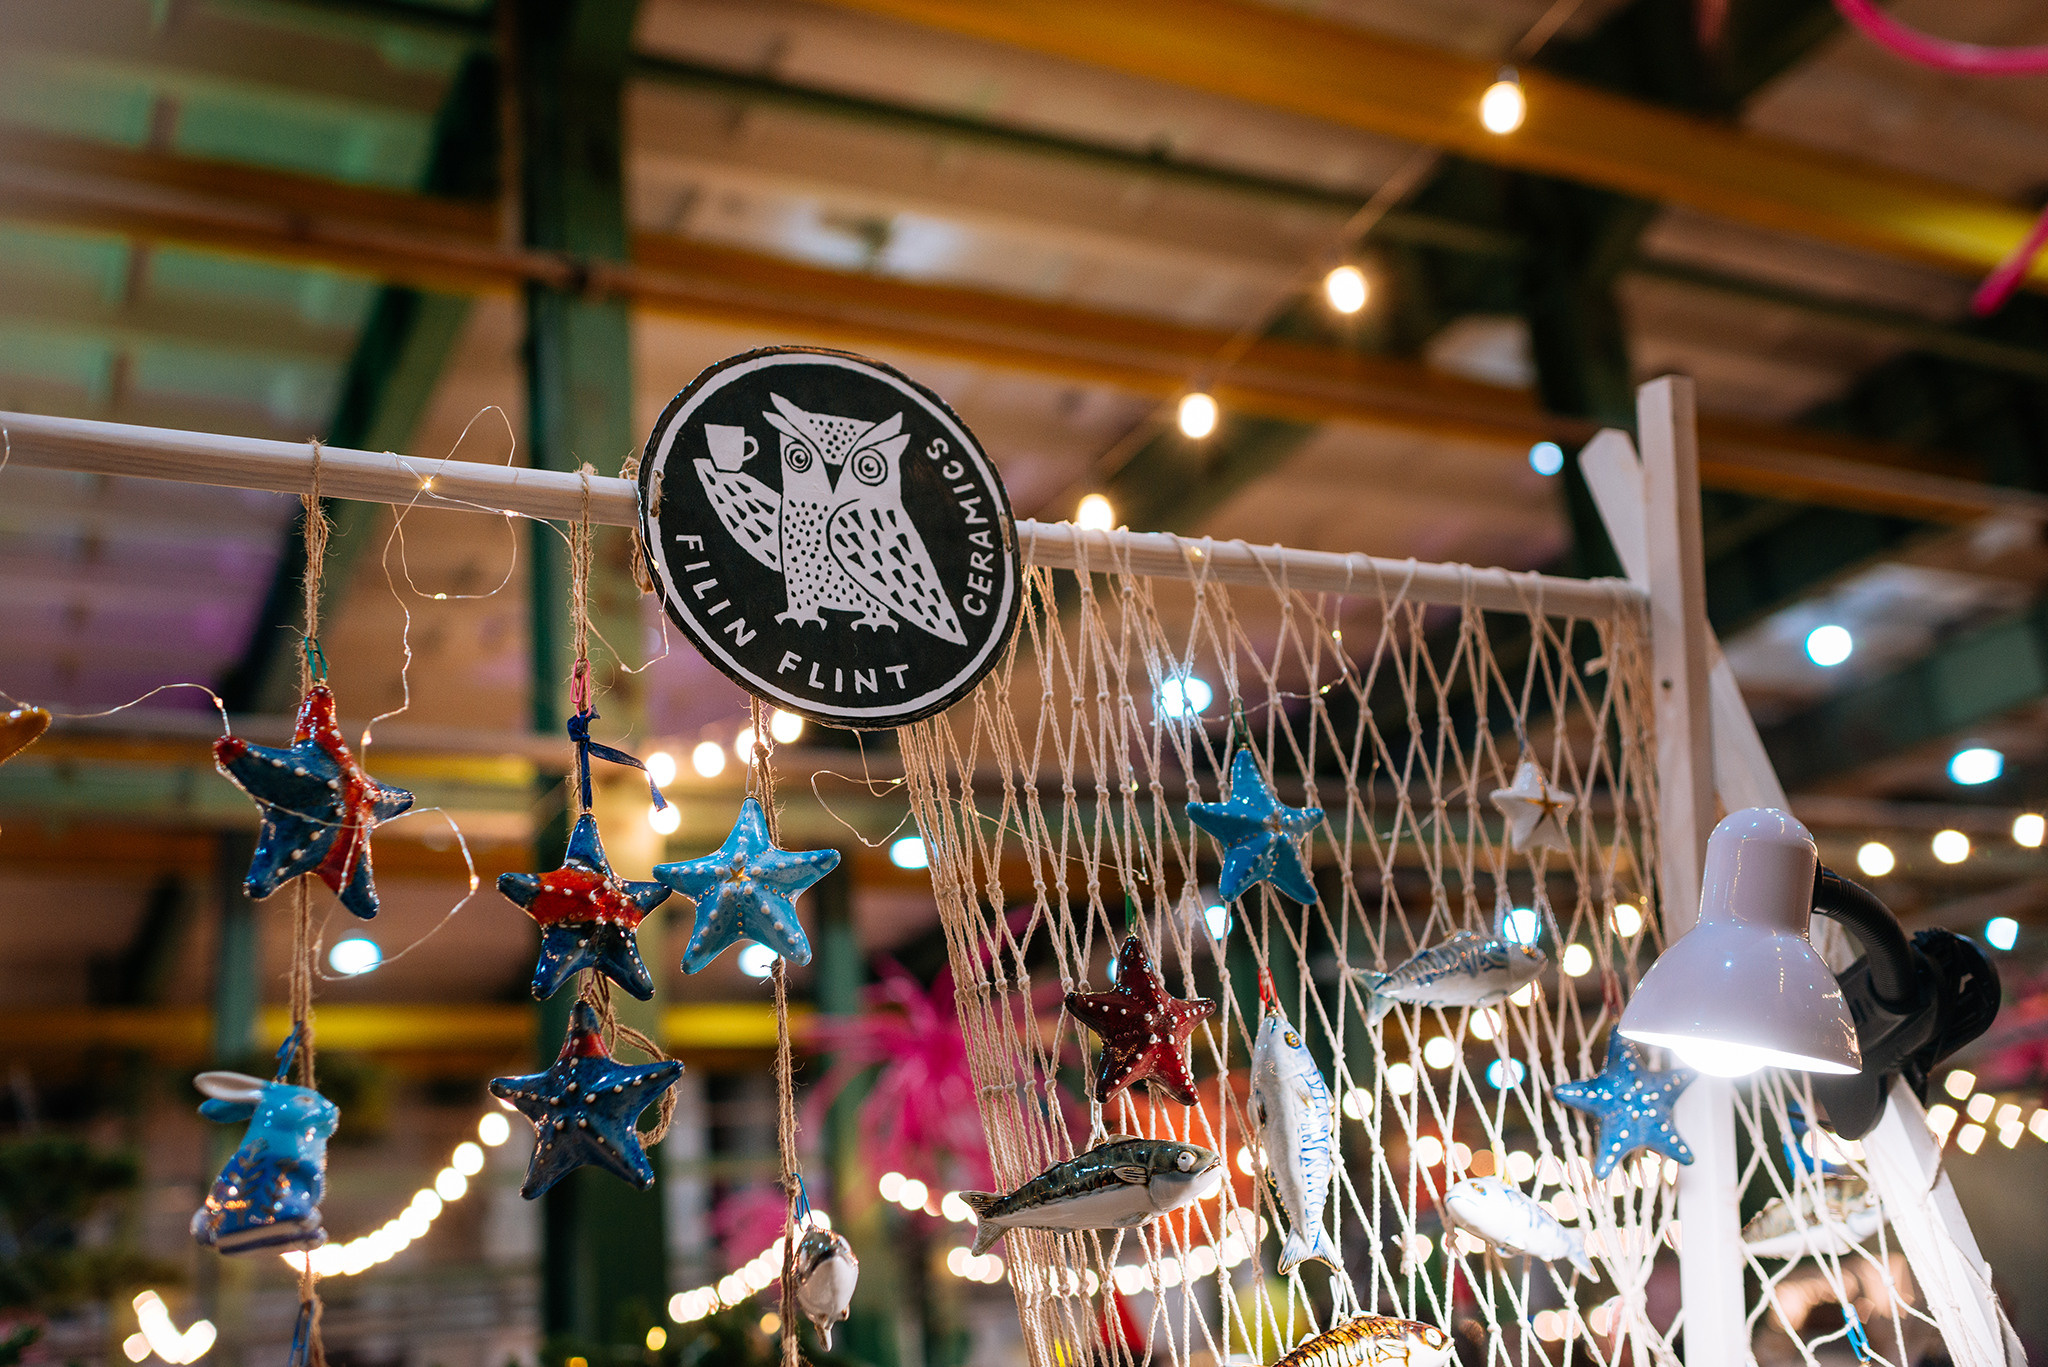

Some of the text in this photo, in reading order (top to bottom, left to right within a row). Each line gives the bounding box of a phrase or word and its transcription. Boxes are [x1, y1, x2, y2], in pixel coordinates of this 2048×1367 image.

[925, 437, 995, 617] CERAMICS
[675, 533, 910, 694] FILIN FLINT
